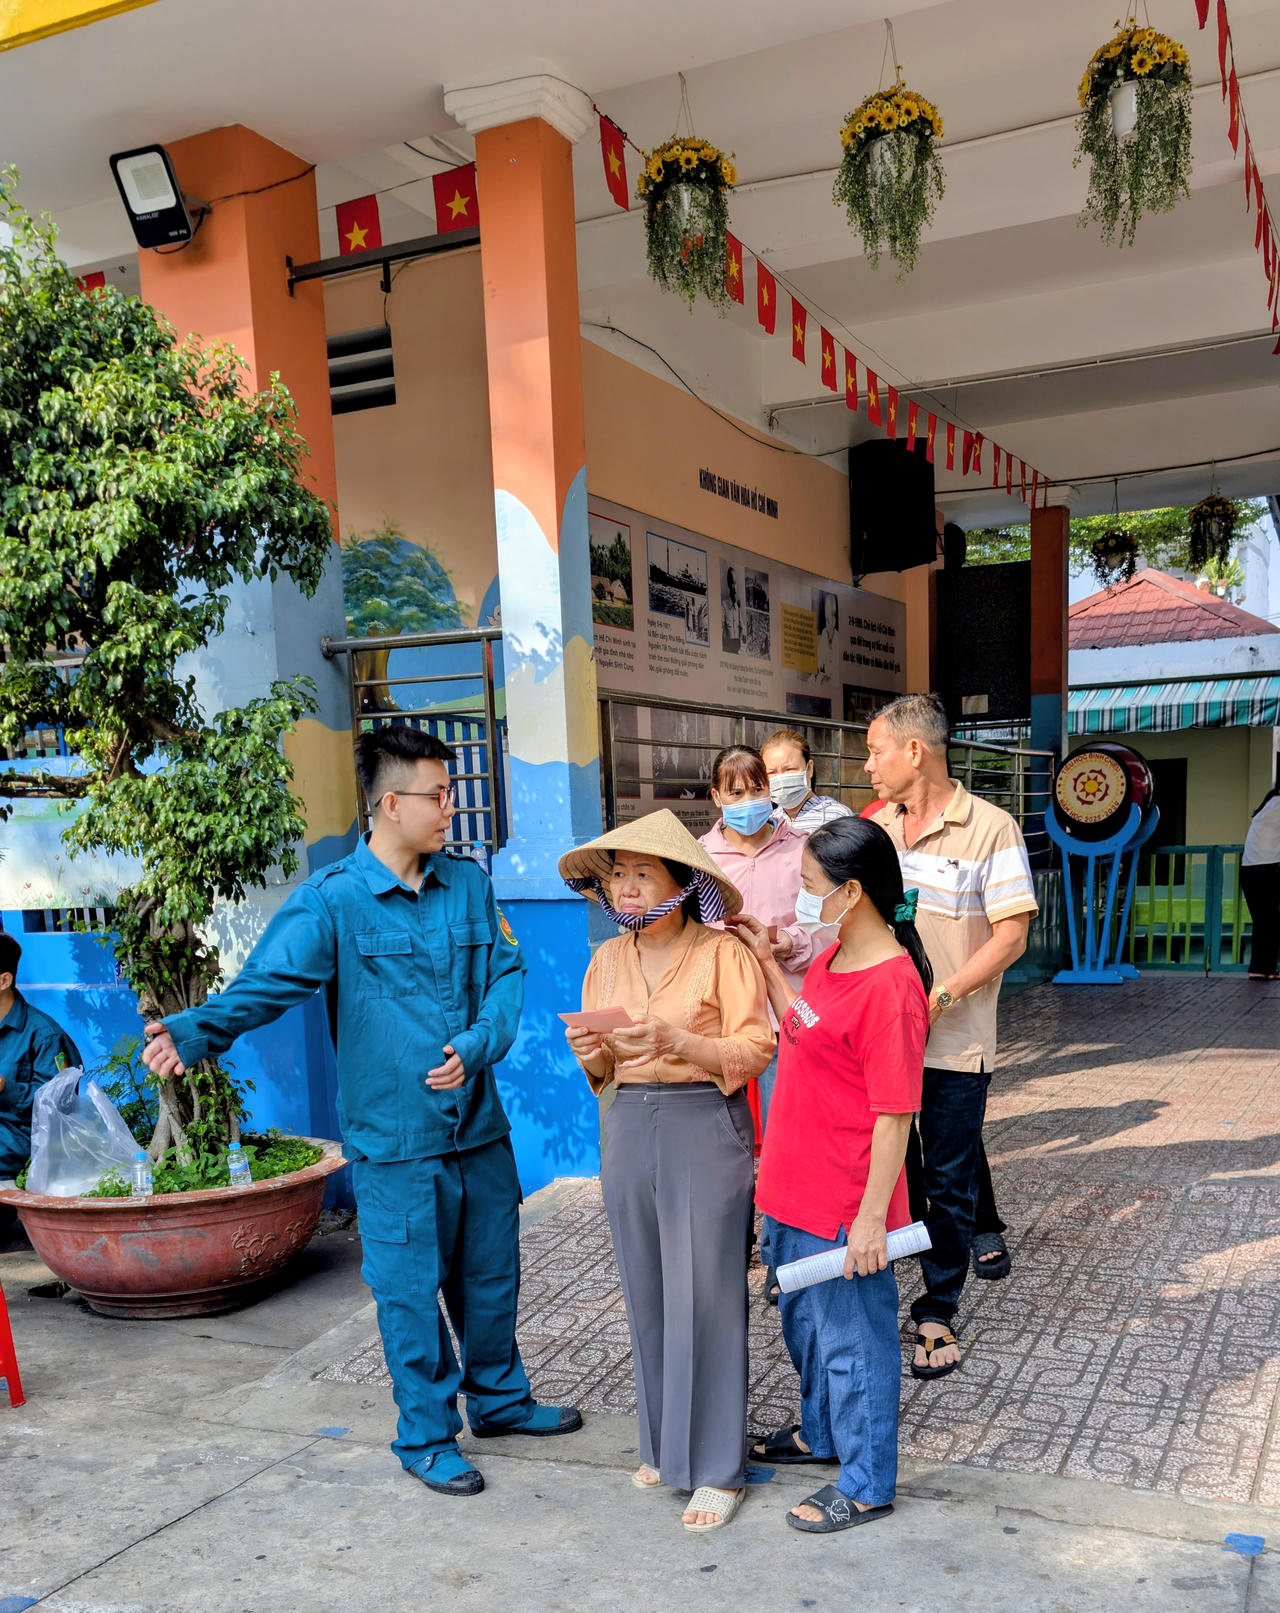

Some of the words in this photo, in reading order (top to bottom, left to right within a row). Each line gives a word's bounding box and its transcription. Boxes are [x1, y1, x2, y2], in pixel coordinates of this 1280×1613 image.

[699, 466, 716, 494] KHÔNG
[717, 476, 729, 500] GIAN
[730, 480, 740, 504] VĂN
